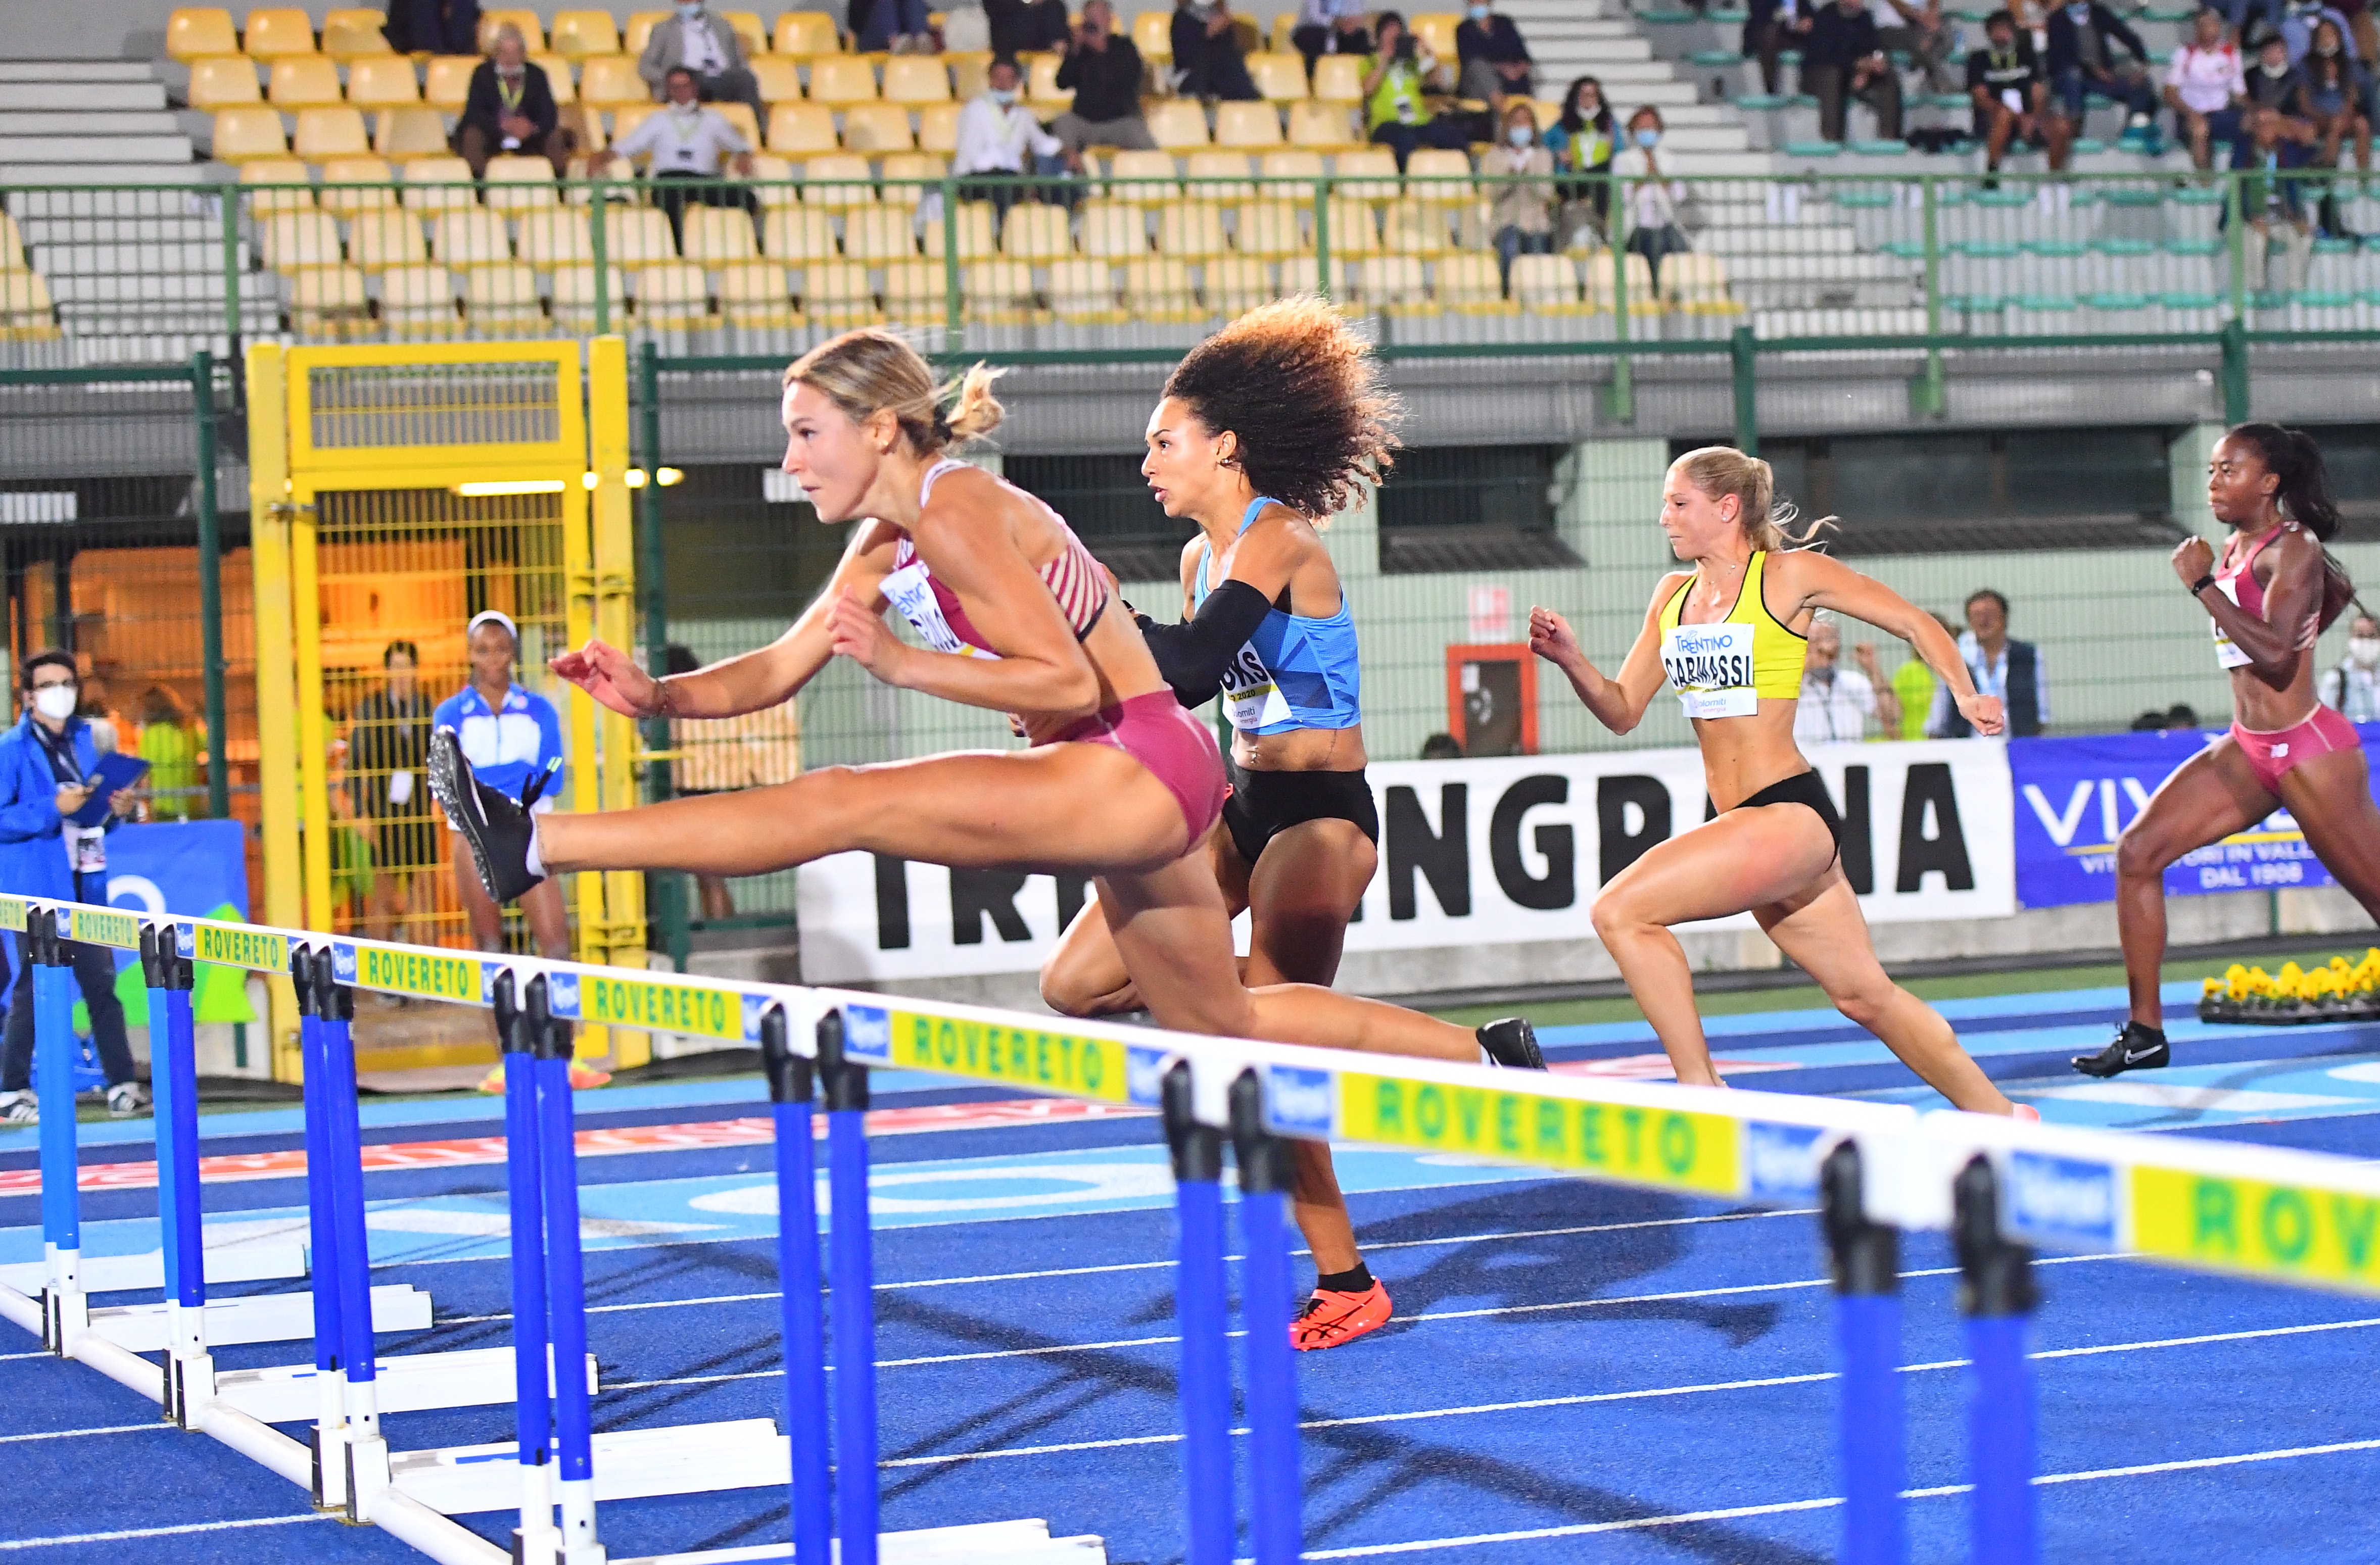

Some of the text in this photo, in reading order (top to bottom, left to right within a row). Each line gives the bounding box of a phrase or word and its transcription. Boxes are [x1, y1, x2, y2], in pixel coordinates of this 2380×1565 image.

[1675, 634, 1733, 654] TRENTINO
[1665, 655, 1750, 688] CARMASSI
[1237, 690, 1256, 700] 2020
[204, 928, 279, 968] ROVERETO
[369, 951, 468, 997] ROVERETO
[595, 980, 726, 1032] ROVERETO
[913, 1017, 1104, 1089] ROVERETO
[1374, 1076, 1697, 1175] ROVERETO
